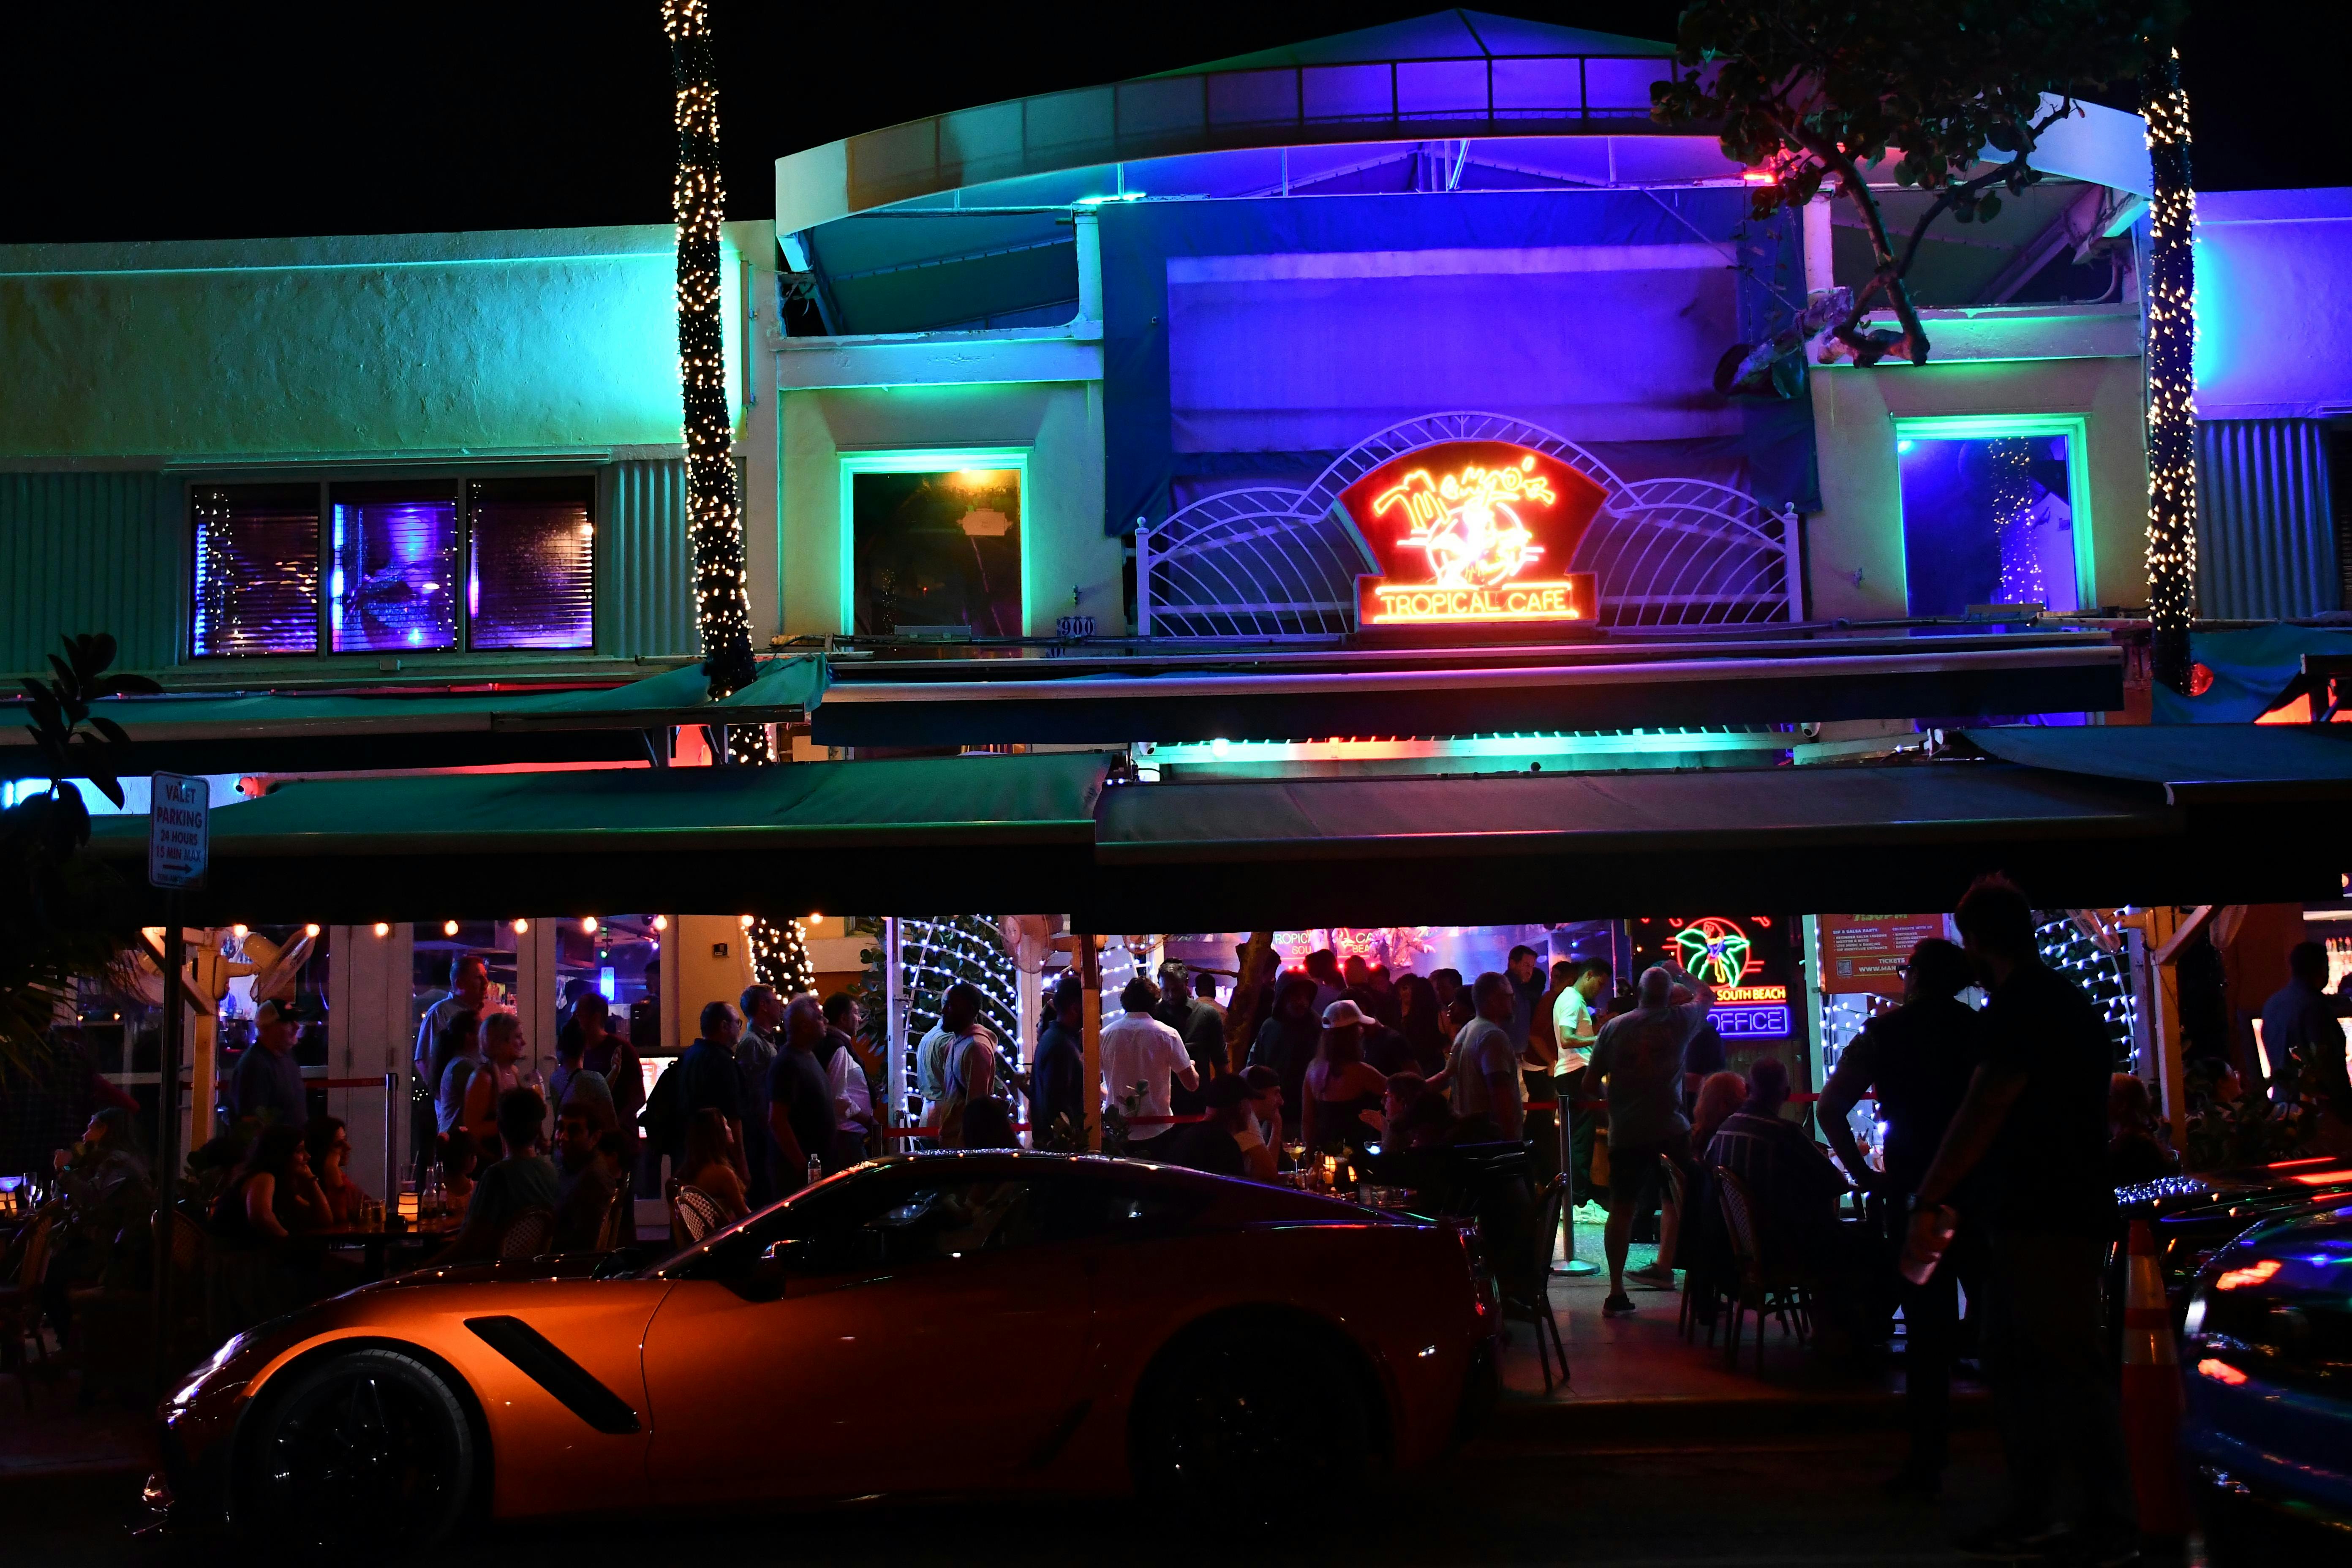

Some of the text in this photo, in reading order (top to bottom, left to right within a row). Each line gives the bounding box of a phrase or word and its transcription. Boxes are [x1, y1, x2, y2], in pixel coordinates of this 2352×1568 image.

[1380, 590, 1566, 615] TROPICAL CAFE
[1062, 620, 1094, 635] 900
[166, 784, 196, 804] VALET
[157, 806, 202, 828] PARKING
[161, 830, 198, 845] 24 HOURS
[157, 845, 201, 863] 15 MIN MAX
[1274, 932, 1311, 945] ROPIC
[1291, 945, 1370, 955] SOU BEA
[1716, 988, 1786, 1001] SOUTH BEACH
[1706, 1012, 1782, 1032] OFFICE
